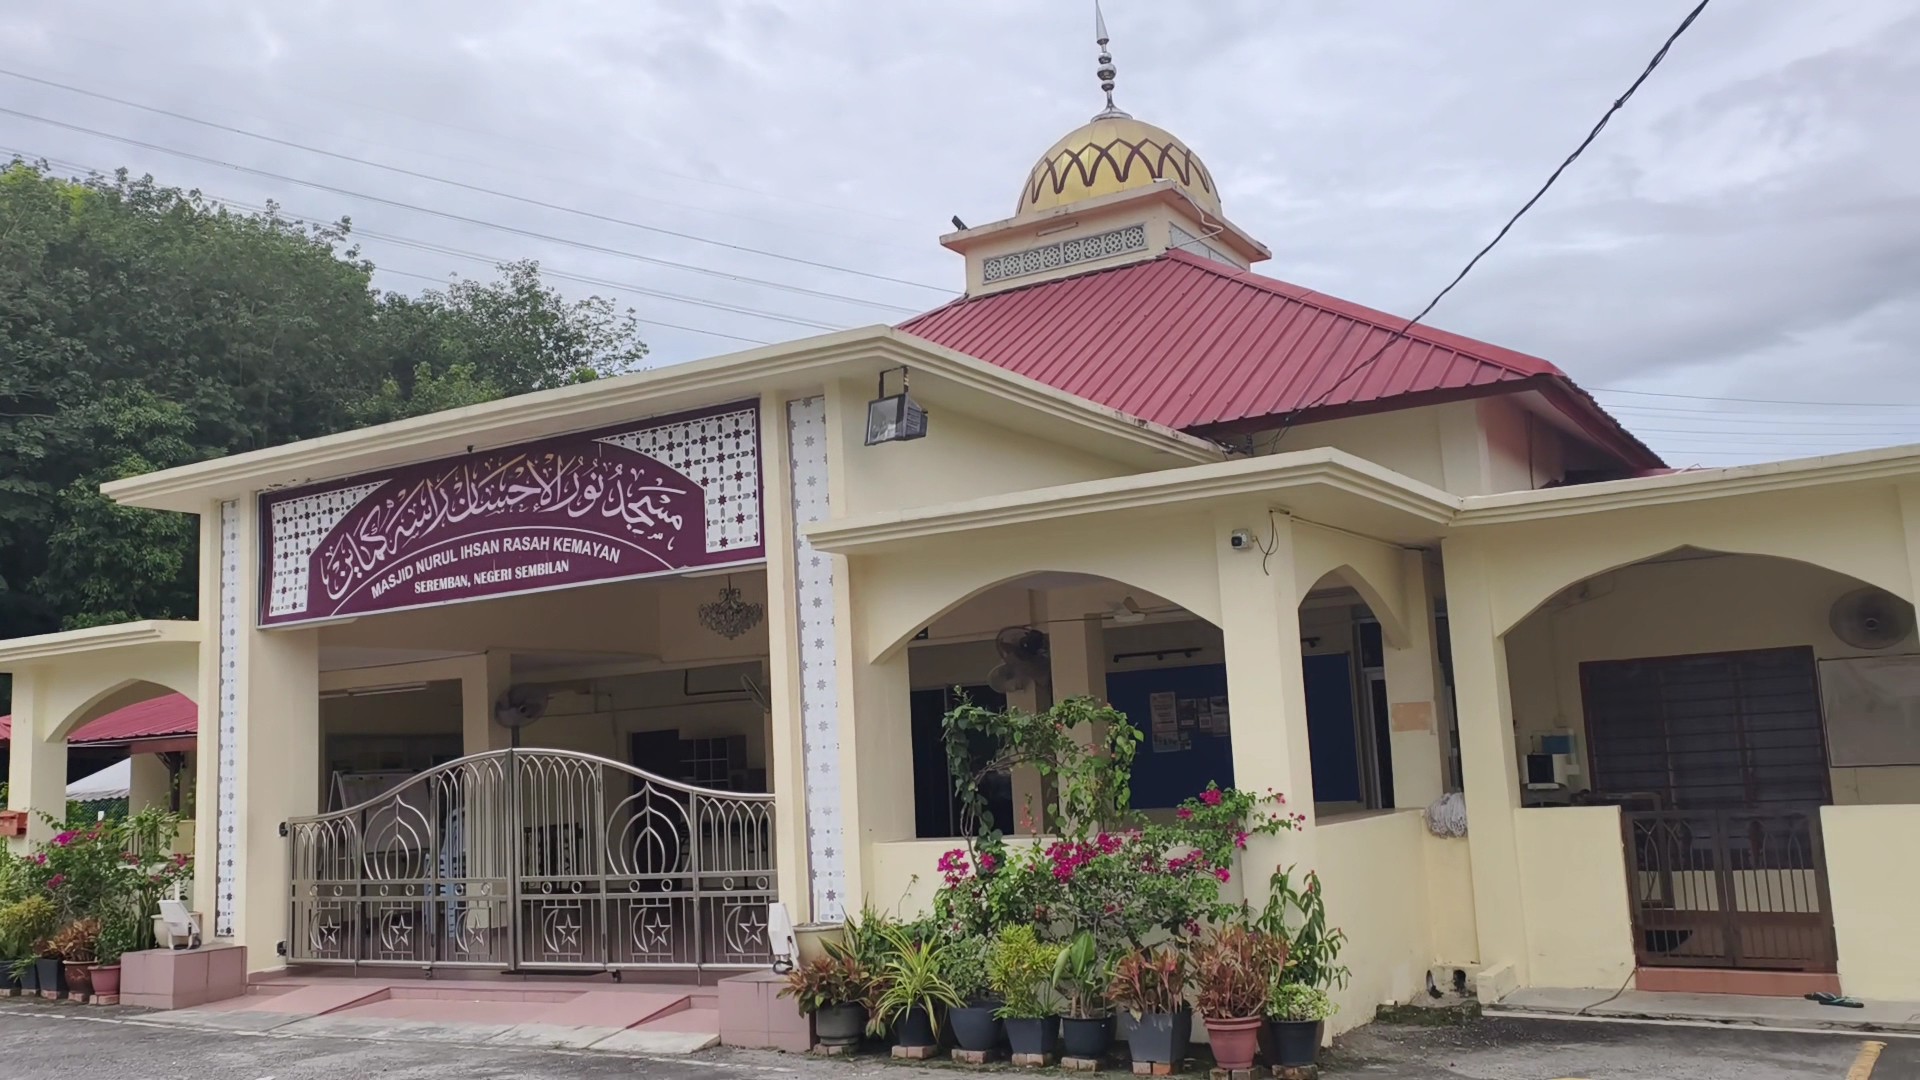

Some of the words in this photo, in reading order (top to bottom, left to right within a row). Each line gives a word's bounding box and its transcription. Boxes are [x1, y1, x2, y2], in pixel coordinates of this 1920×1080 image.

[540, 456, 604, 517] نور
[602, 465, 687, 550] مسجد
[371, 565, 414, 599] MASJID
[416, 550, 458, 575] NURUL
[461, 539, 500, 560] IHSAN
[503, 536, 550, 552] RASAH
[553, 537, 621, 564] KEMAYAN
[414, 574, 472, 594] SEREMBAN,
[474, 567, 512, 585] NEGERI
[515, 560, 570, 580] SEMBILAN
